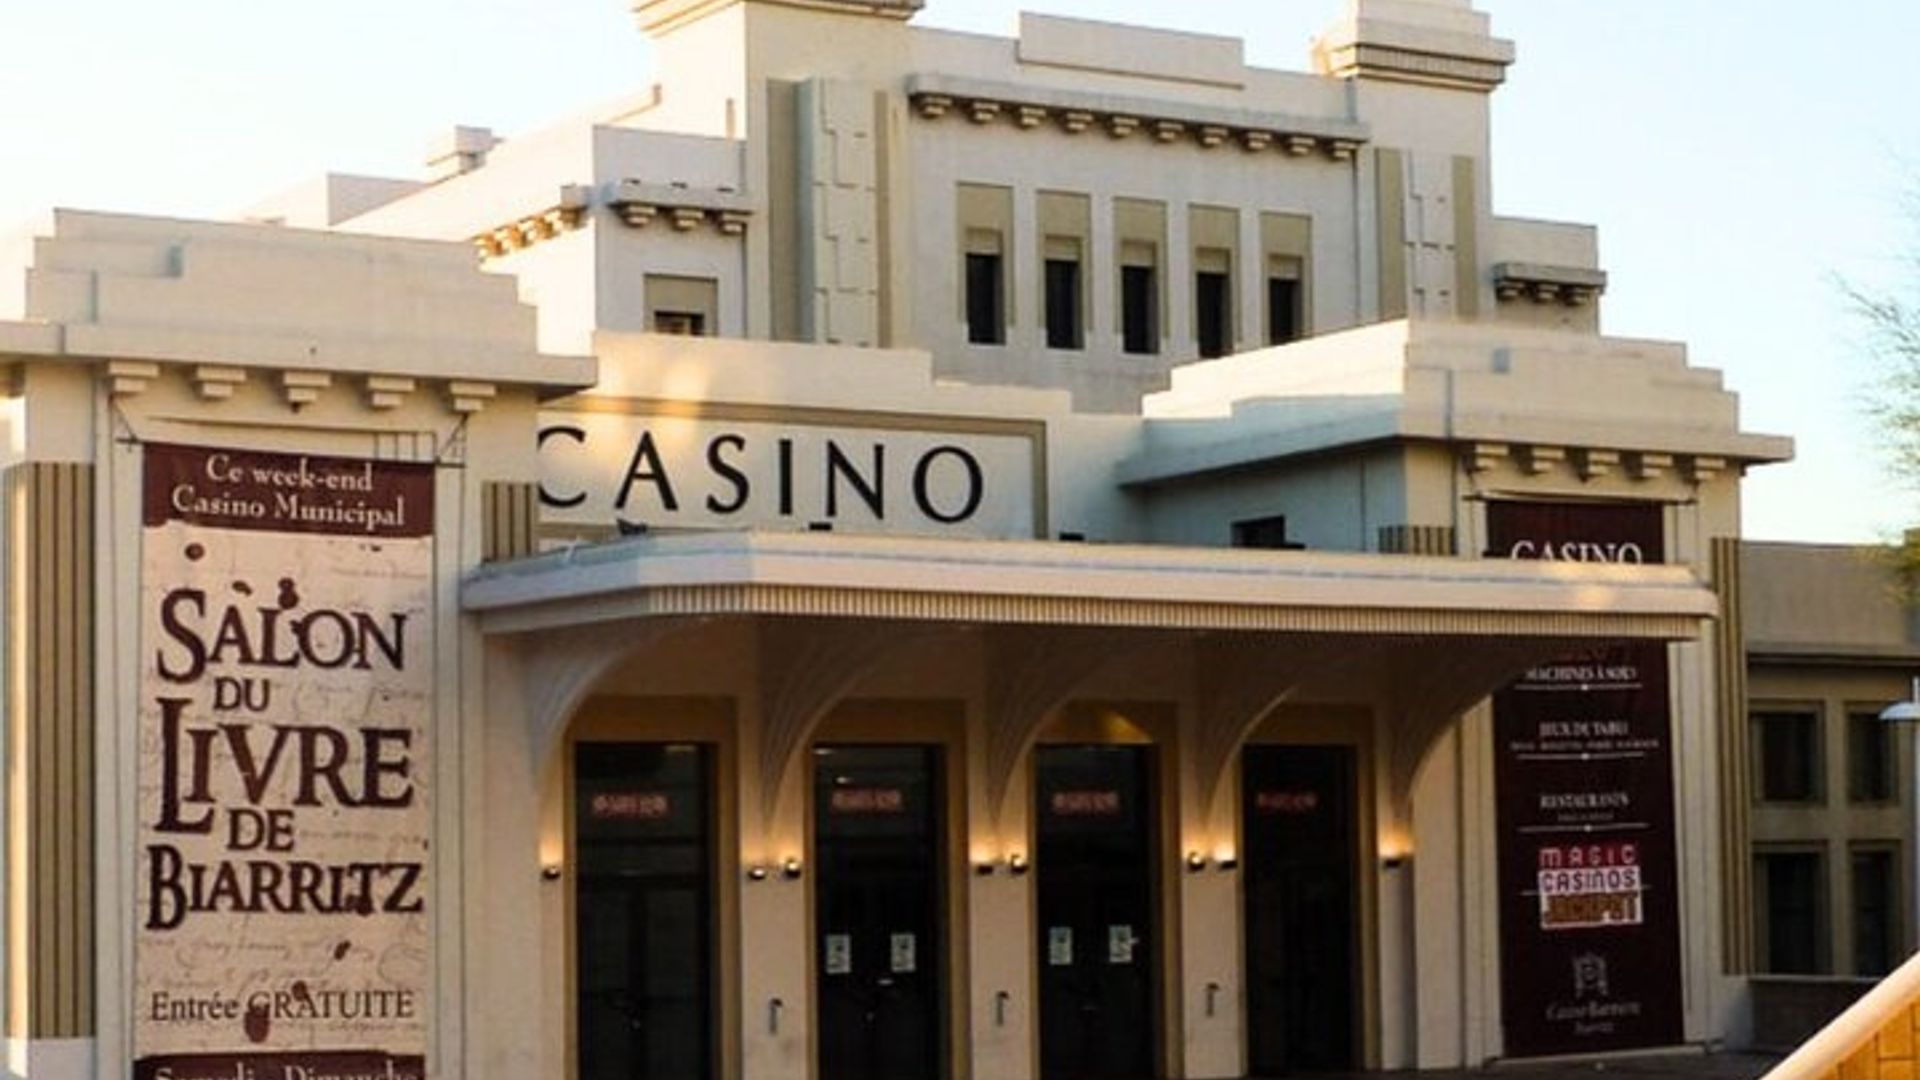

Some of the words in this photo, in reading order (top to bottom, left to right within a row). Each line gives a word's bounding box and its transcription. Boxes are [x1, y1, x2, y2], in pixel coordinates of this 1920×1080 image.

[206, 454, 244, 483] Ce
[253, 457, 373, 492] week-end
[537, 425, 984, 524] CASINO
[172, 484, 266, 518] Casino
[274, 492, 405, 531] Municipal
[156, 588, 408, 684] SALON
[213, 677, 271, 712] DU
[153, 697, 414, 834] LIVRE
[226, 808, 295, 852] DE
[1539, 844, 1636, 867] MAGIC
[145, 844, 424, 931] BIARRITZ
[1543, 868, 1637, 893] CASINOS
[151, 991, 240, 1021] Entrée
[247, 990, 415, 1020] GRATUITE
